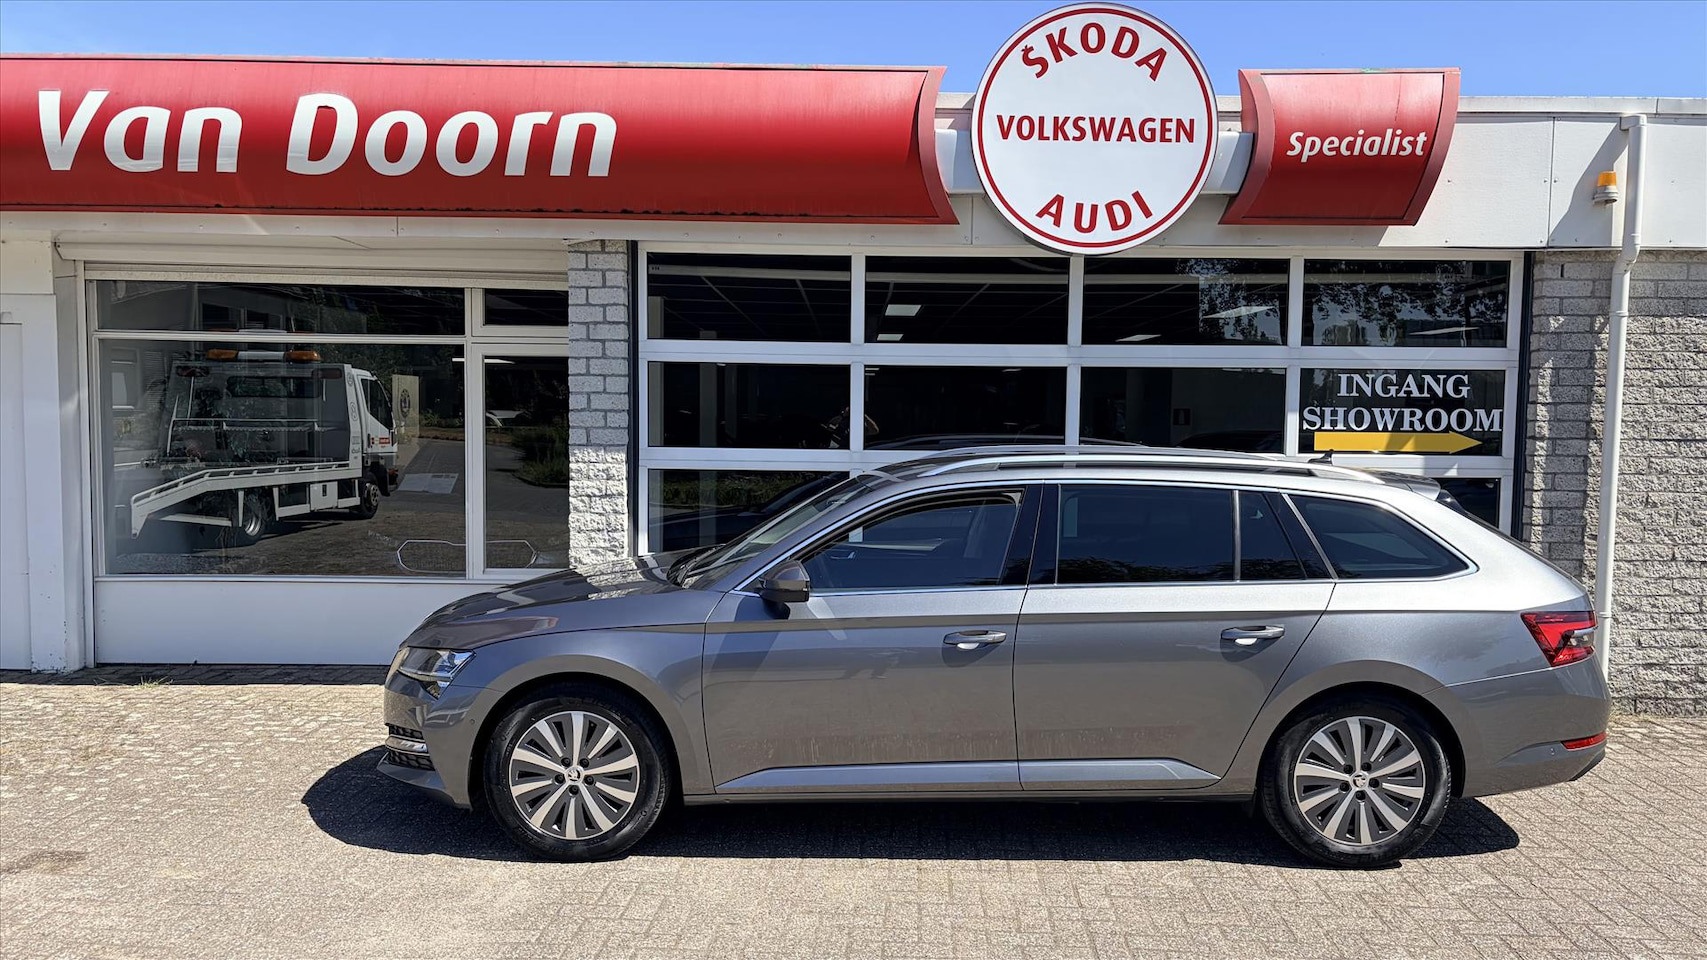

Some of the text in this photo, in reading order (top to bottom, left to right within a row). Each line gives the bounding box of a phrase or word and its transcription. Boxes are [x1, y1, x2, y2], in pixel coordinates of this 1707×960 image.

[1020, 22, 1169, 82] ŠKODA
[38, 89, 618, 177] Van Doorn
[996, 114, 1196, 144] VOLKSWAGEN
[1286, 128, 1428, 163] Specialist
[1035, 190, 1154, 234] AUDI
[1336, 373, 1471, 399] INGANG
[1302, 406, 1504, 433] SHOWROOM
